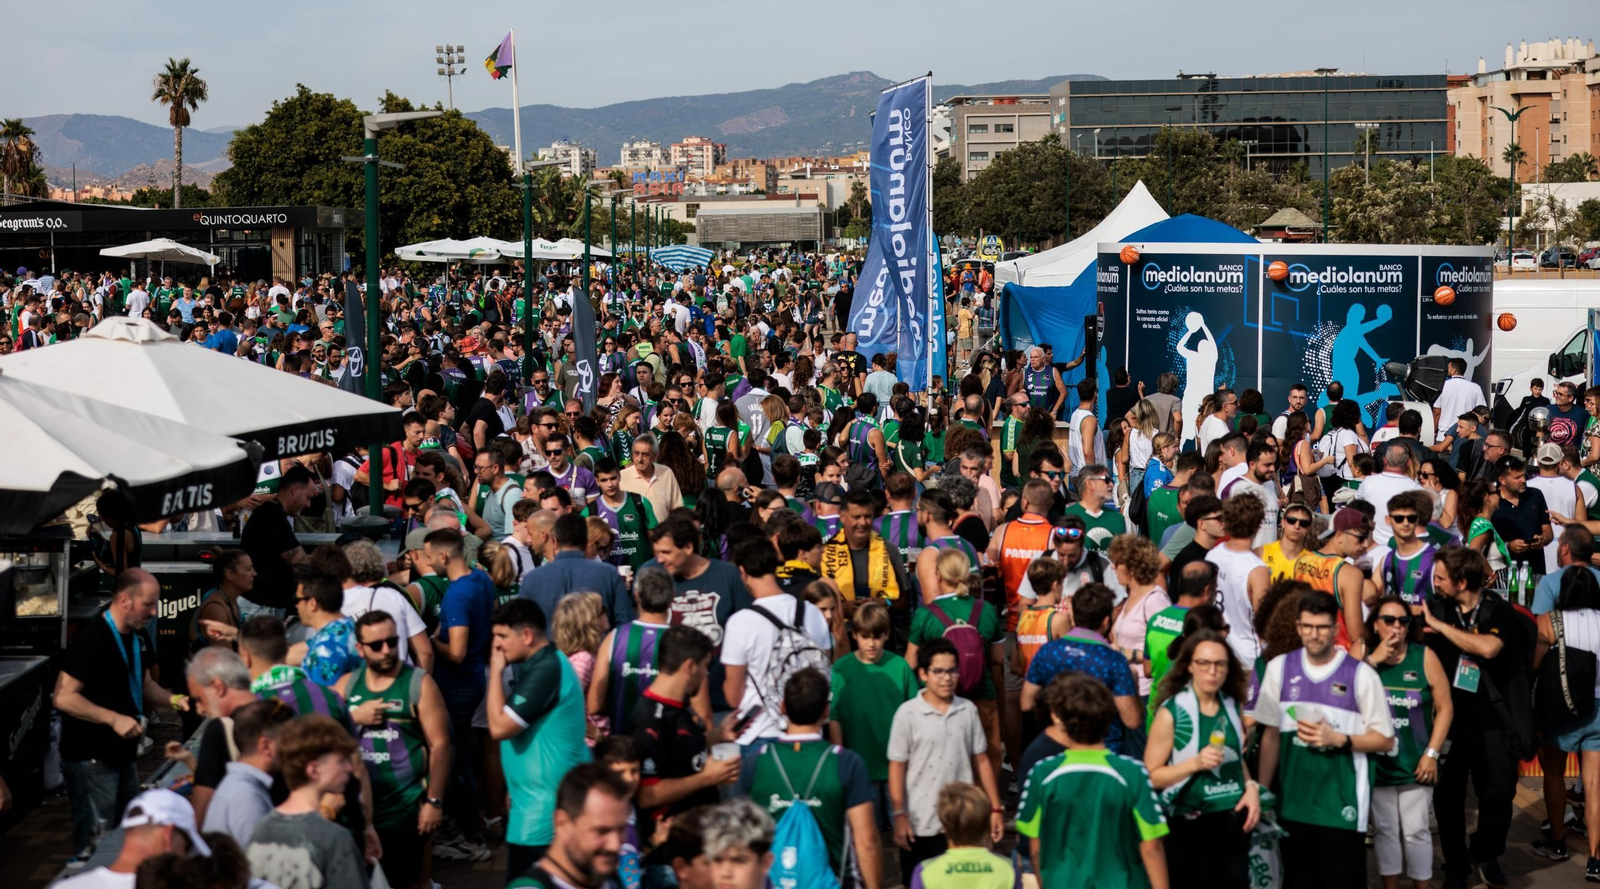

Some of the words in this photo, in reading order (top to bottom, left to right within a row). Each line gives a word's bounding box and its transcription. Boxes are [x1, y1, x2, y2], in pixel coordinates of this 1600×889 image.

[633, 171, 684, 183] MAXI
[633, 182, 684, 195] ASIA
[0, 214, 45, 231] eagram's
[1145, 266, 1244, 283] mediolanum
[1219, 264, 1244, 272] BANCO
[1289, 266, 1403, 284] mediolanum
[1164, 284, 1189, 294] ¿Cuáles
[1216, 285, 1243, 293] metas?
[1316, 284, 1347, 295] ¿Cuáles
[1364, 285, 1375, 293] tus
[1377, 284, 1403, 293] metas?
[1456, 284, 1472, 294] ¿Cuáles
[750, 413, 763, 435] 11
[277, 429, 336, 455] BRUTUS
[618, 531, 639, 540] Unicaja
[609, 546, 637, 556] málaga
[158, 588, 201, 619] iguel
[1385, 695, 1418, 709] nicaja
[1204, 781, 1240, 795] Unicaja
